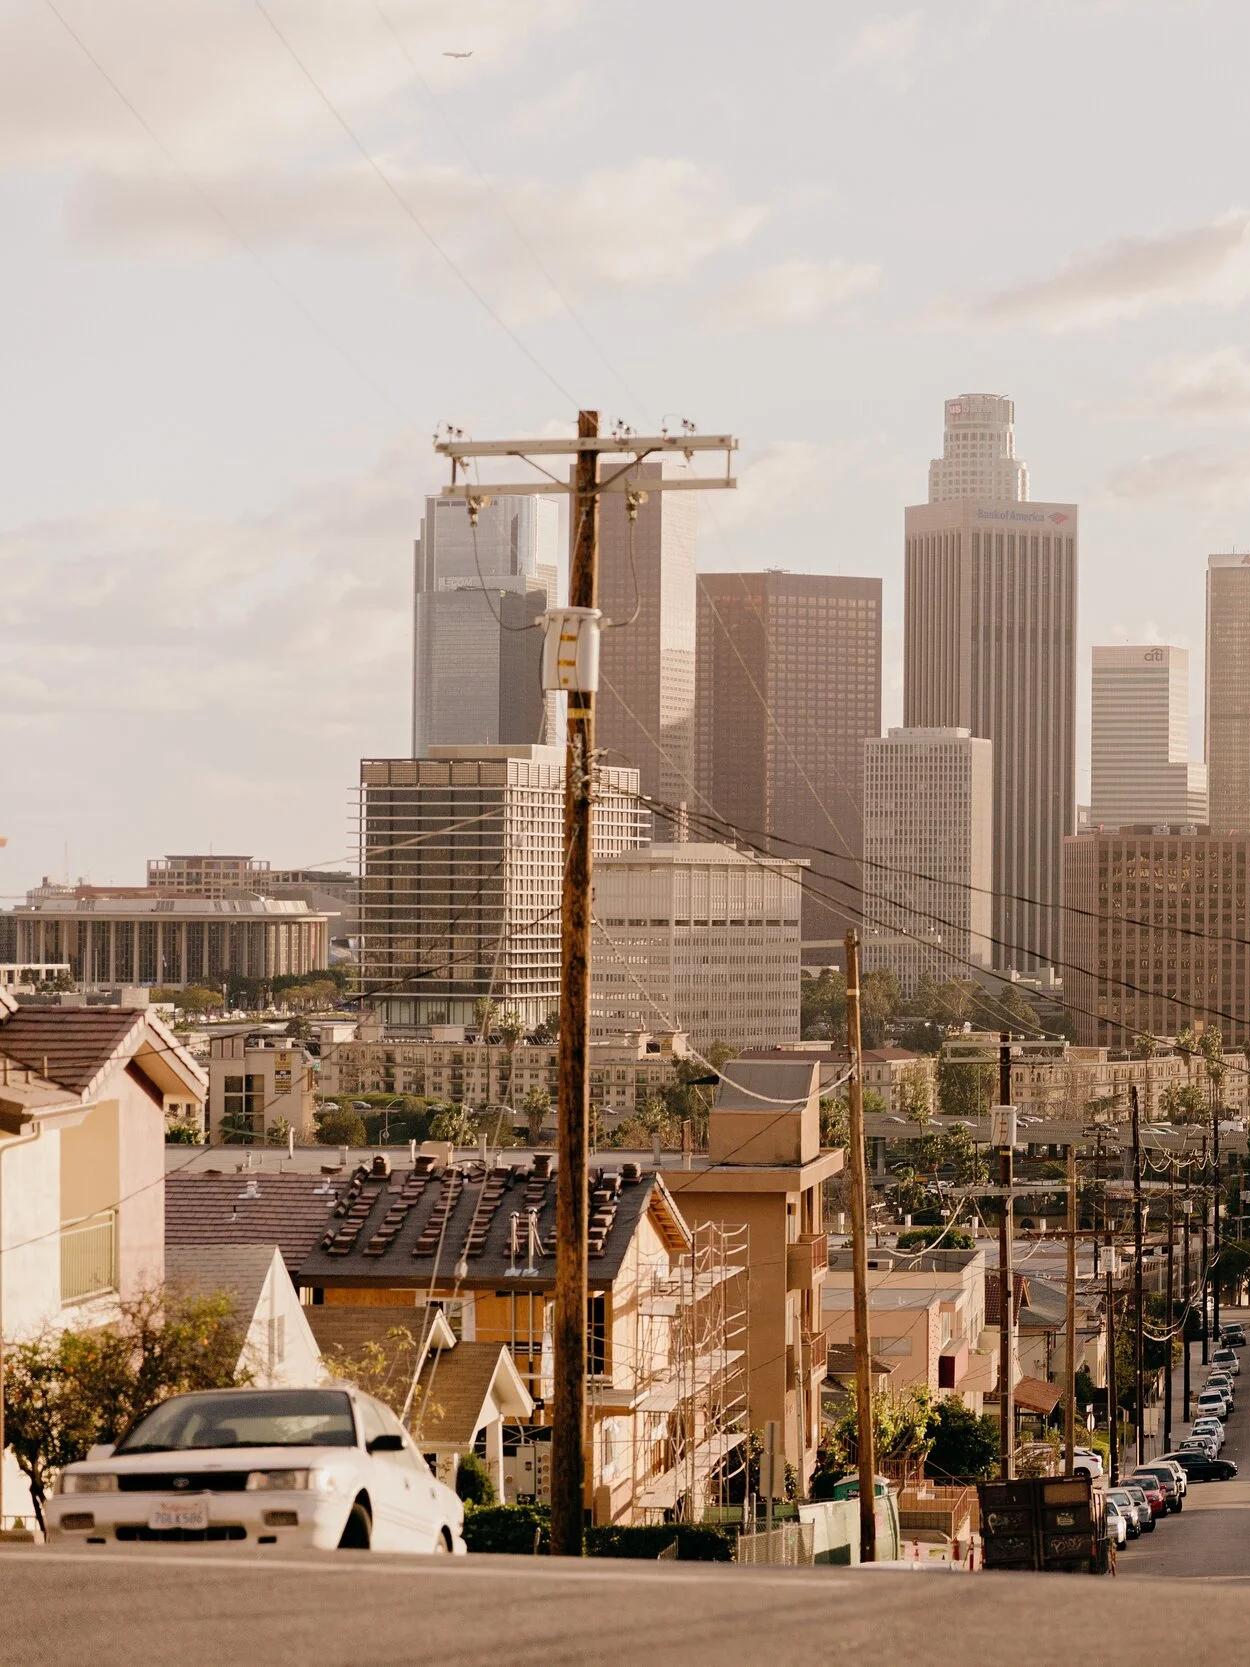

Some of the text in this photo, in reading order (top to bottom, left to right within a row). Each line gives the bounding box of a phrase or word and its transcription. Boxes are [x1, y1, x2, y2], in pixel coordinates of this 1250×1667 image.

[977, 509, 1045, 522] Bank of America
[1144, 648, 1163, 661] citi
